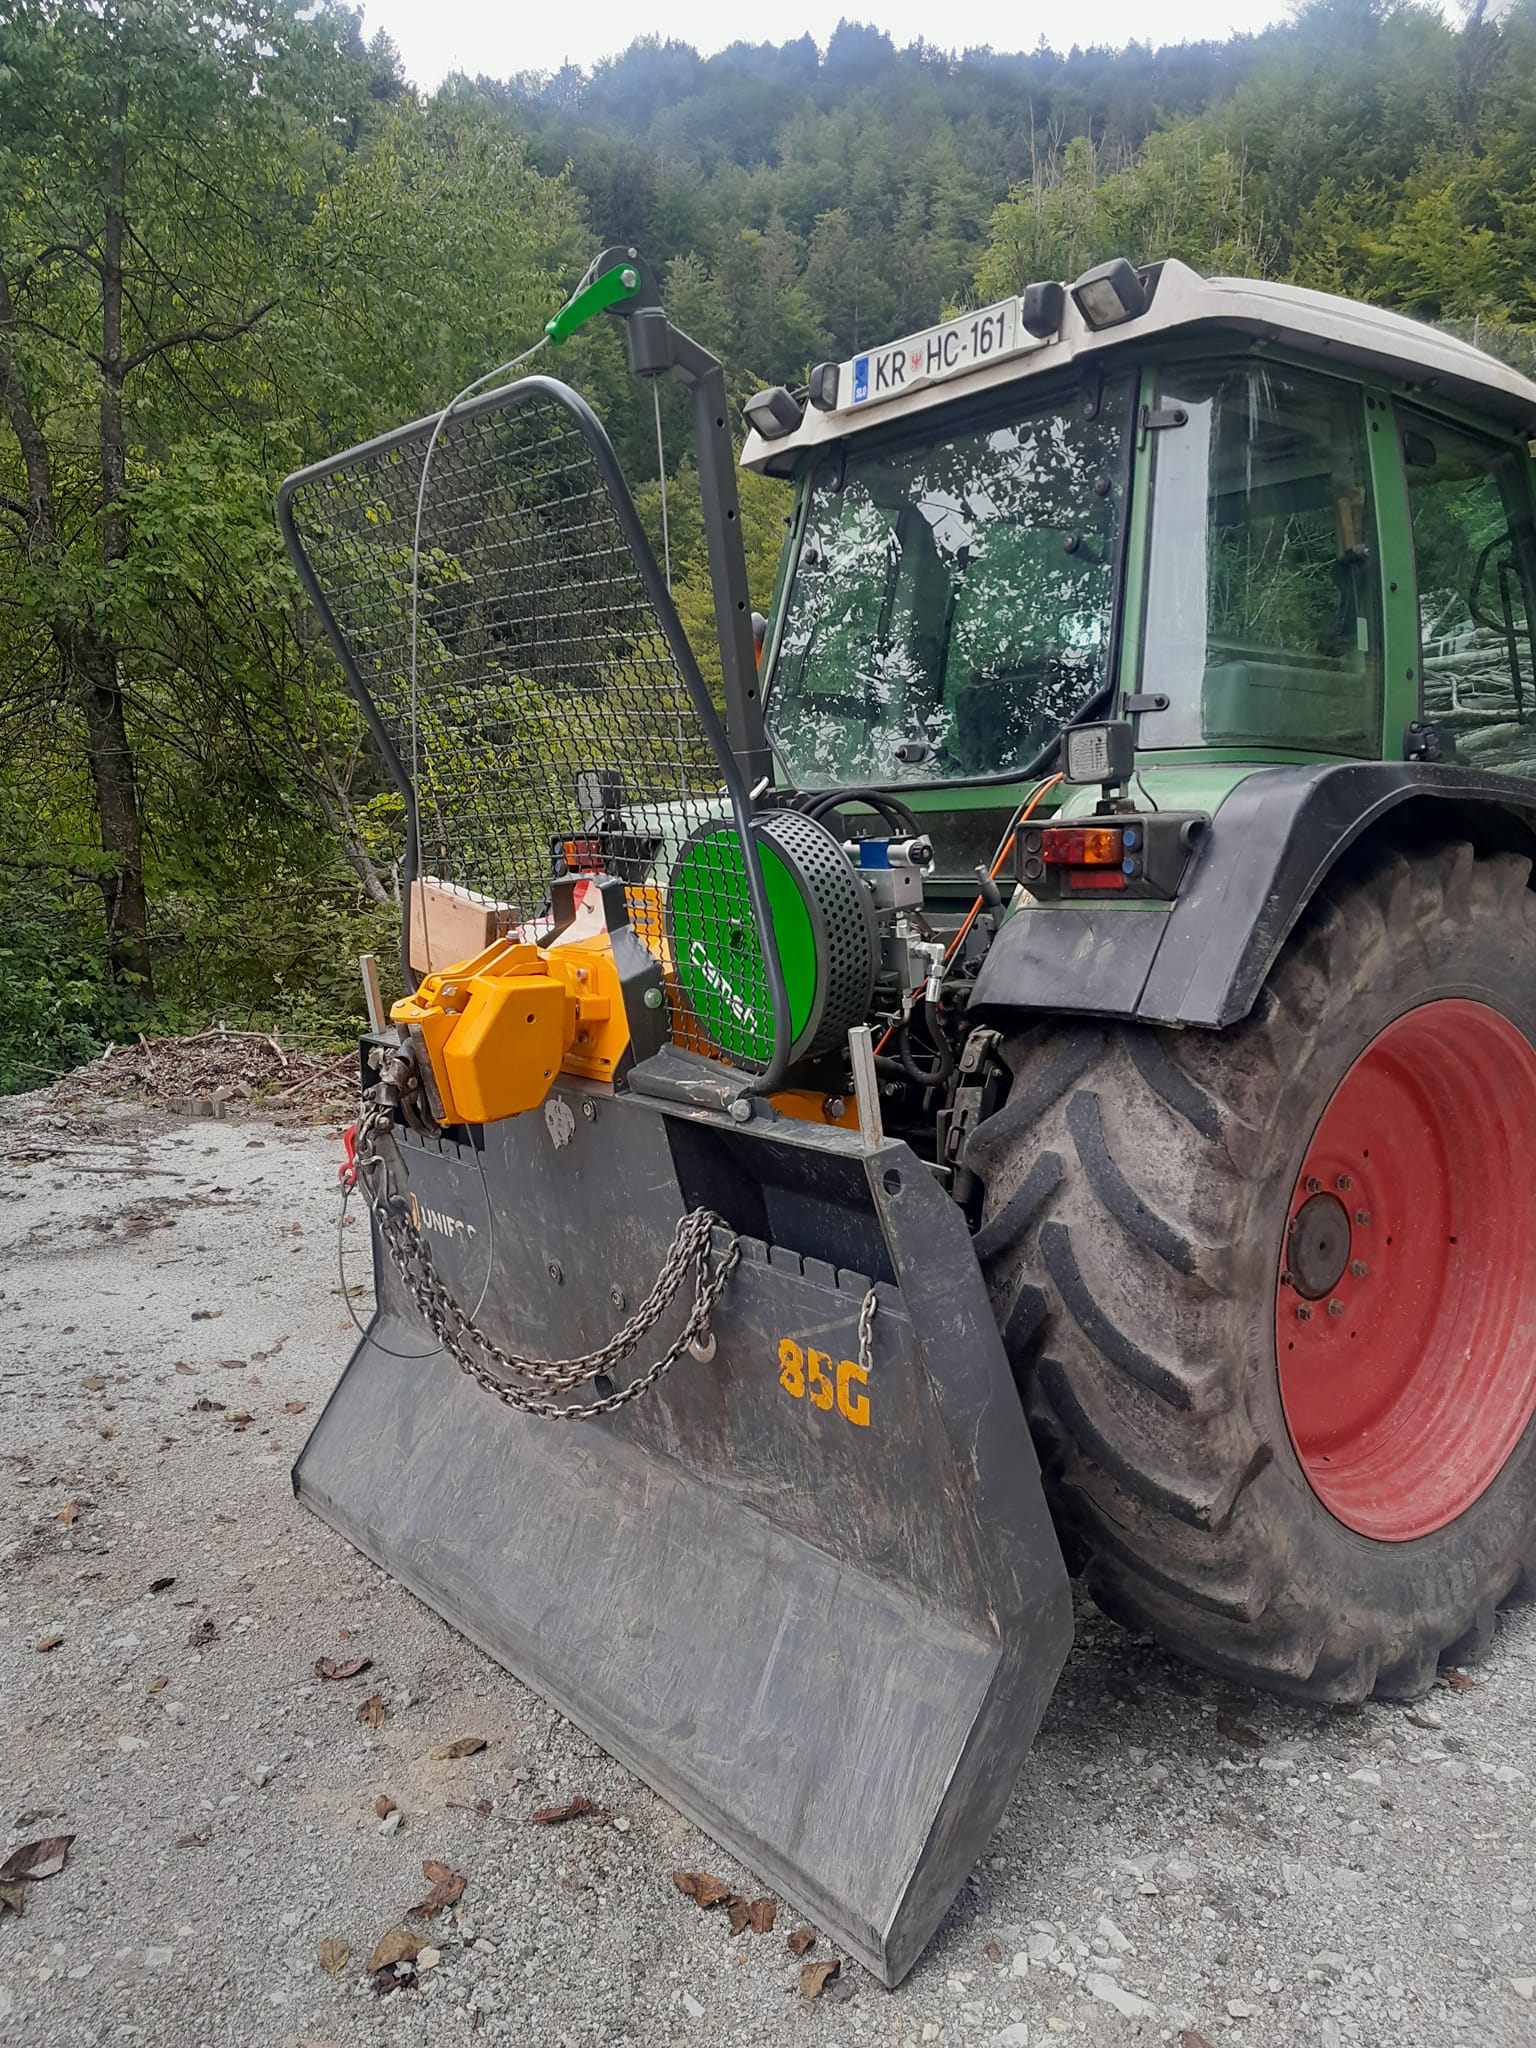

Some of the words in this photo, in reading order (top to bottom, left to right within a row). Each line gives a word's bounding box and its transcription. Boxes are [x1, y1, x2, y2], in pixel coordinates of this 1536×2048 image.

[876, 350, 905, 391] KR
[926, 311, 1006, 374] HC-161
[855, 385, 867, 399] SLO
[778, 1337, 870, 1426] 85G
